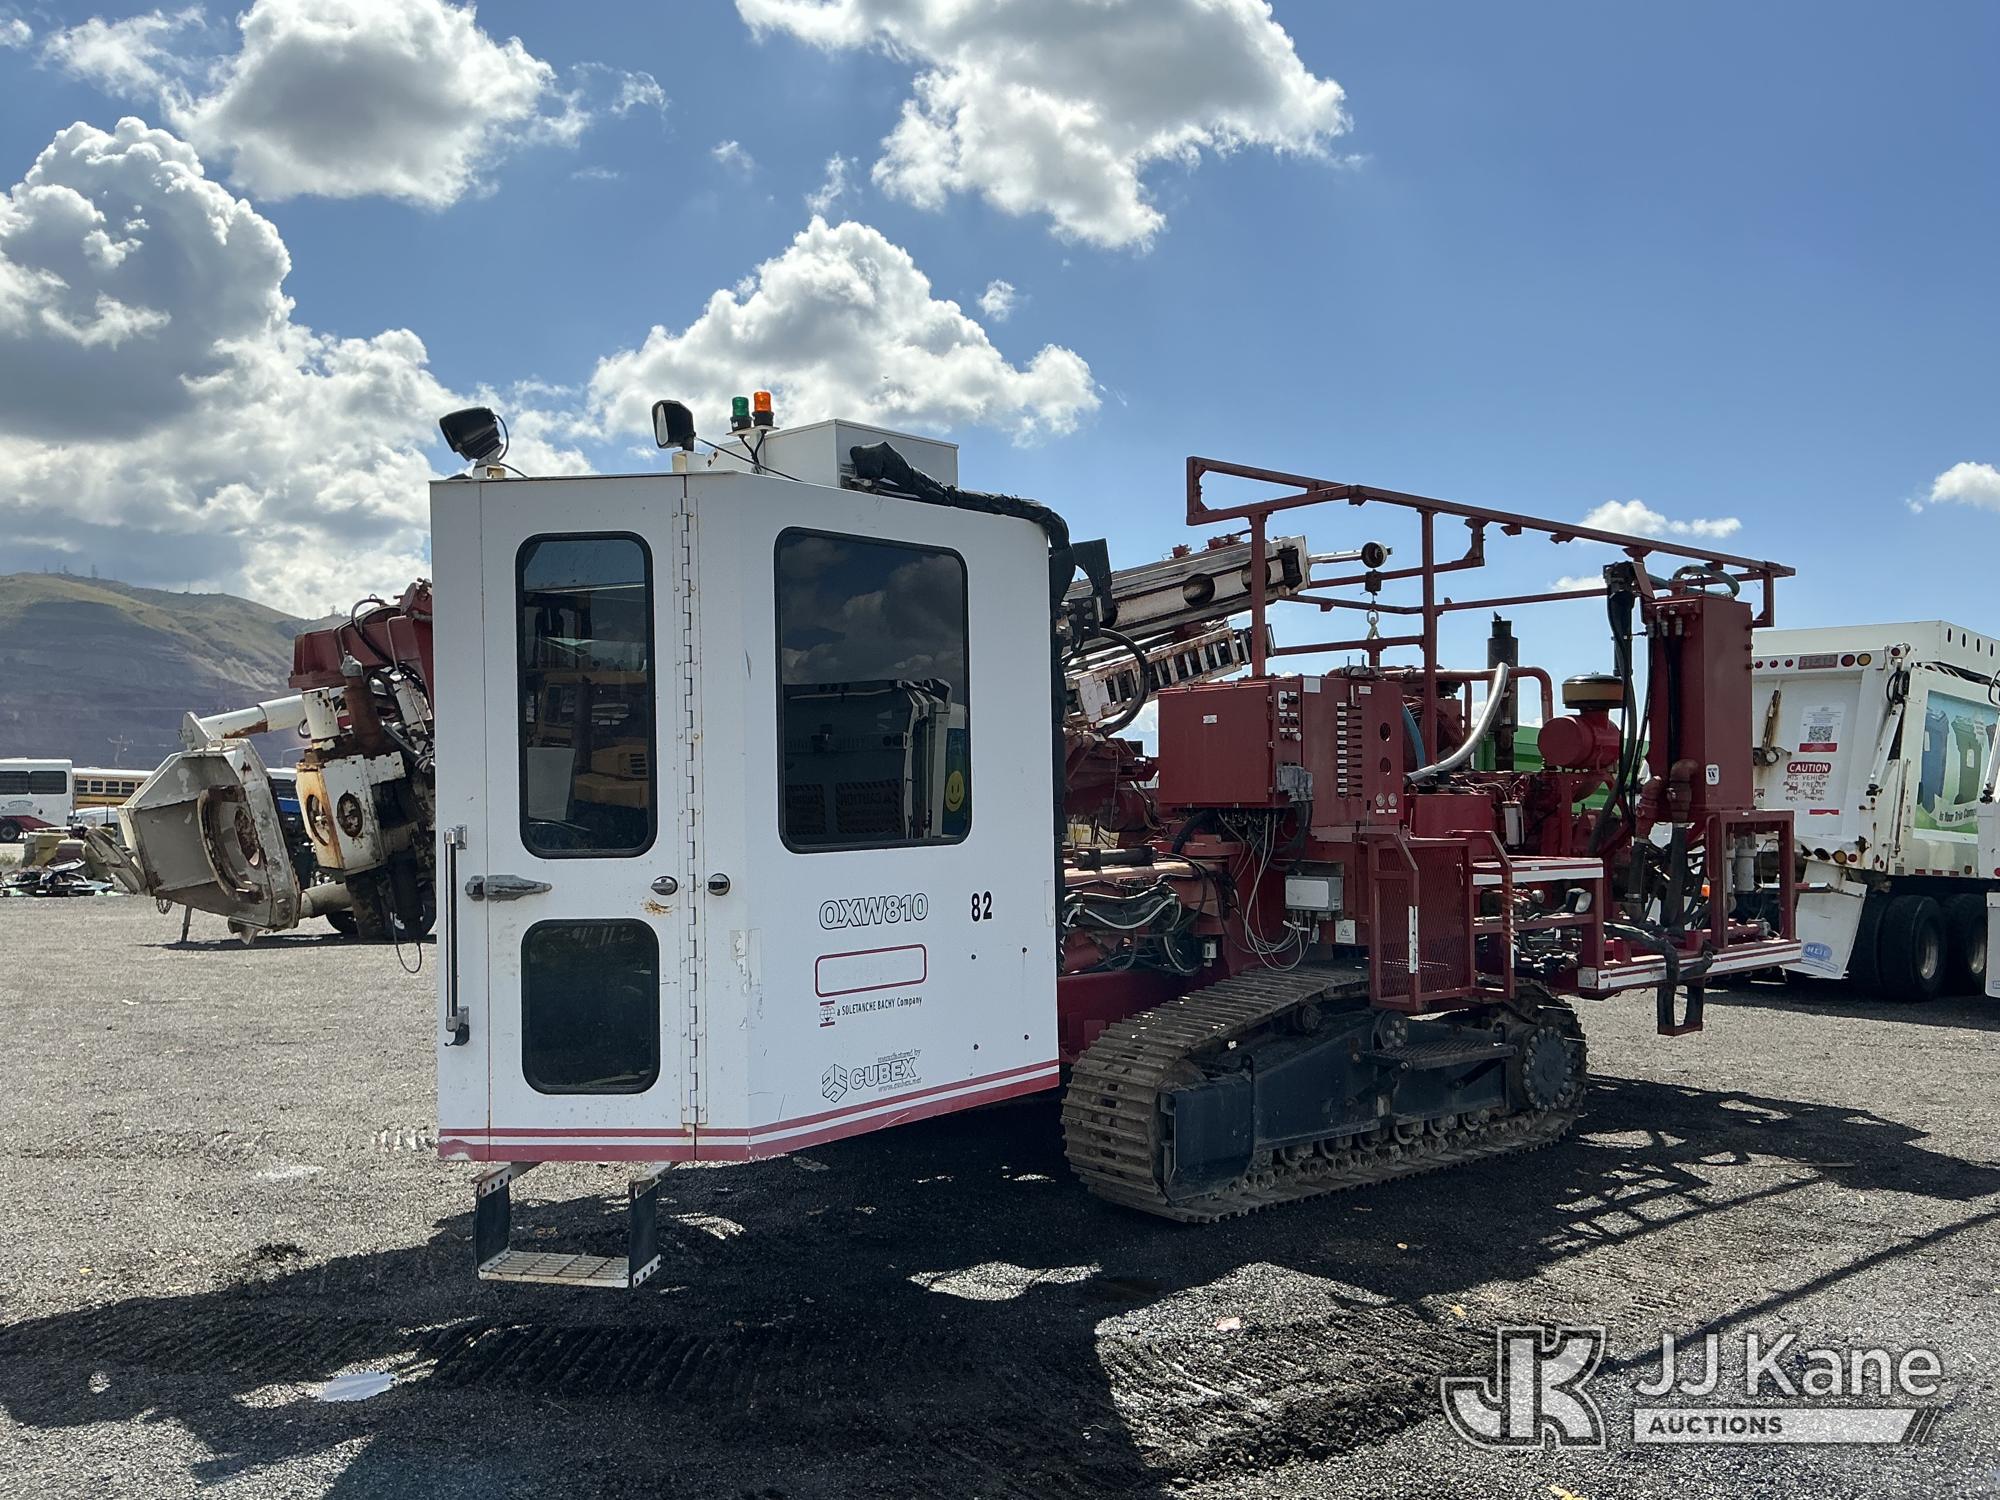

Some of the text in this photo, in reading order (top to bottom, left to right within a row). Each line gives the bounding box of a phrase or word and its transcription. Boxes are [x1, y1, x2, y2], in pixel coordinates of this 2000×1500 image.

[1789, 763, 1829, 773] CAUTION
[971, 891, 993, 922] 82
[836, 996, 922, 1017] a SOLETANCHE BACHY Company
[850, 1056, 917, 1090] CUBEX
